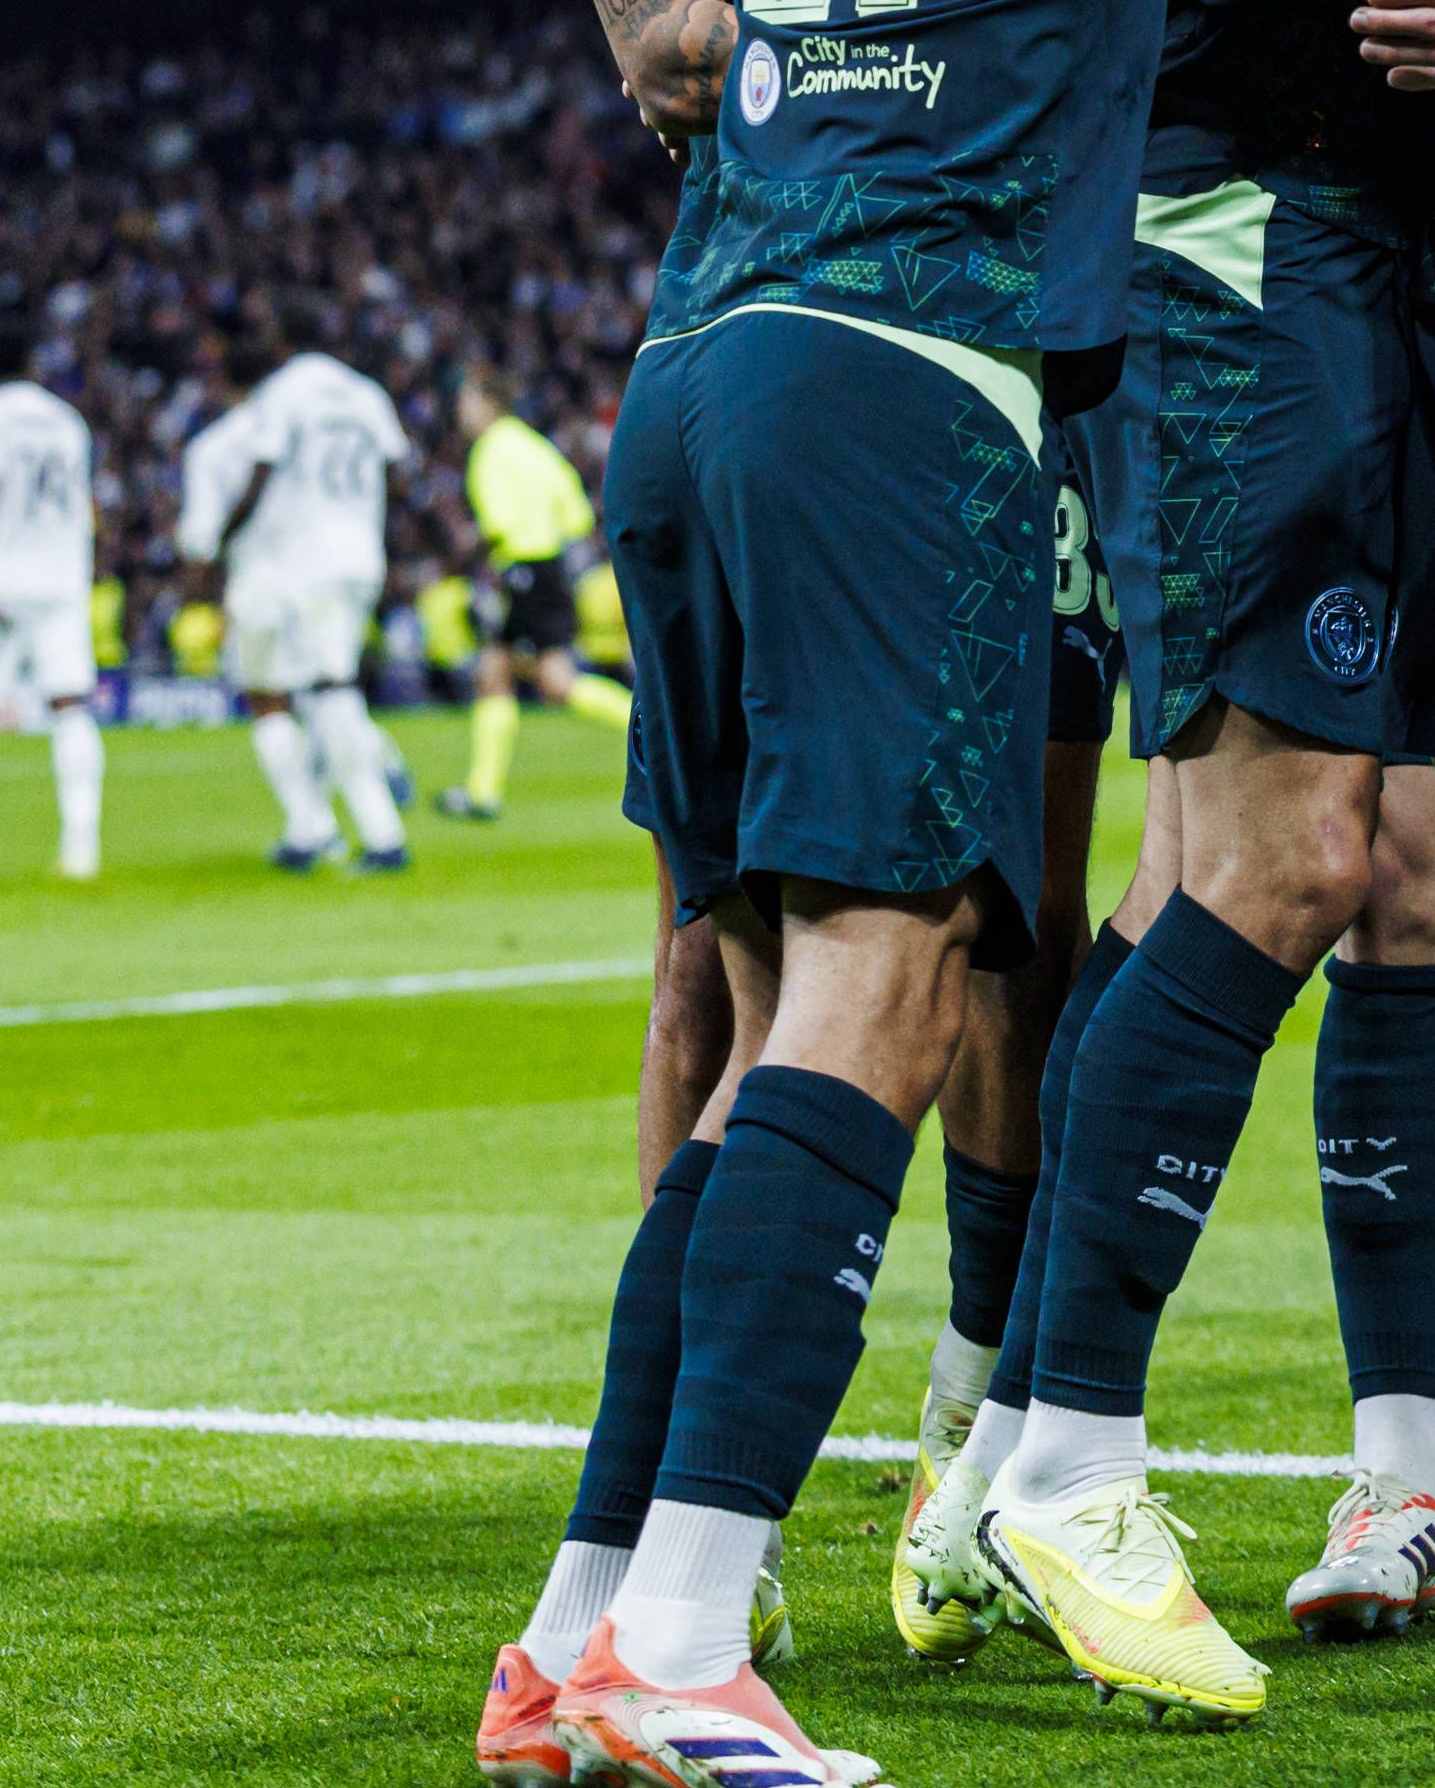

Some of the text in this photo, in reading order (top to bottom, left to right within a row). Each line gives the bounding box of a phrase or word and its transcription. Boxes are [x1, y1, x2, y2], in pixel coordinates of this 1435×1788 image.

[801, 35, 891, 66] City in the
[787, 43, 946, 110] Community
[1157, 1154, 1225, 1183] CIT
